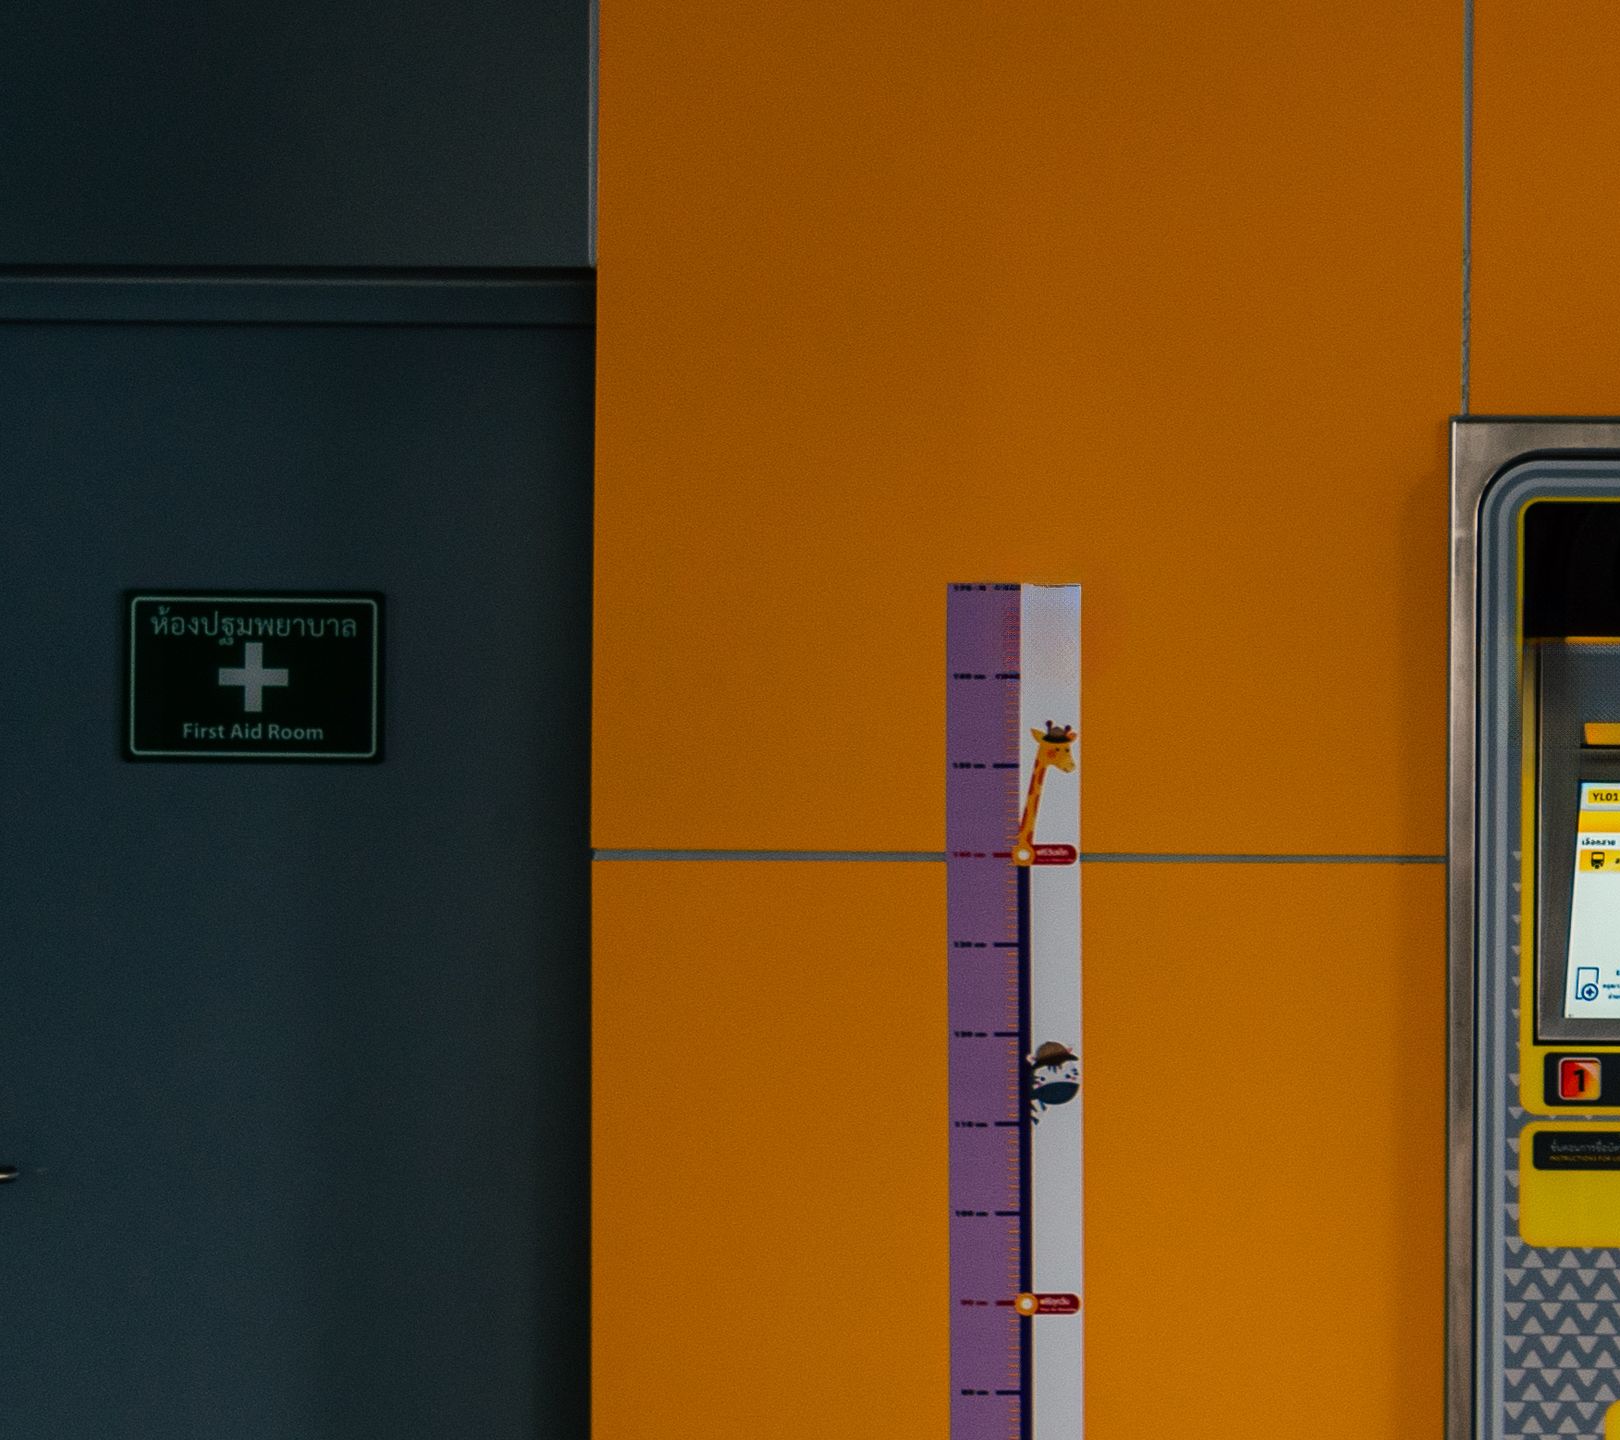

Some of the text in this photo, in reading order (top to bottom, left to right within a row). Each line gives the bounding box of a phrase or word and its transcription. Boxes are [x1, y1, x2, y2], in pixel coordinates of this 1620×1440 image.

[151, 606, 358, 646] ห้องปฐมพยาบาล
[182, 722, 324, 740] First Aid Room
[1592, 793, 1619, 802] YL01
[1573, 1067, 1586, 1092] 1
